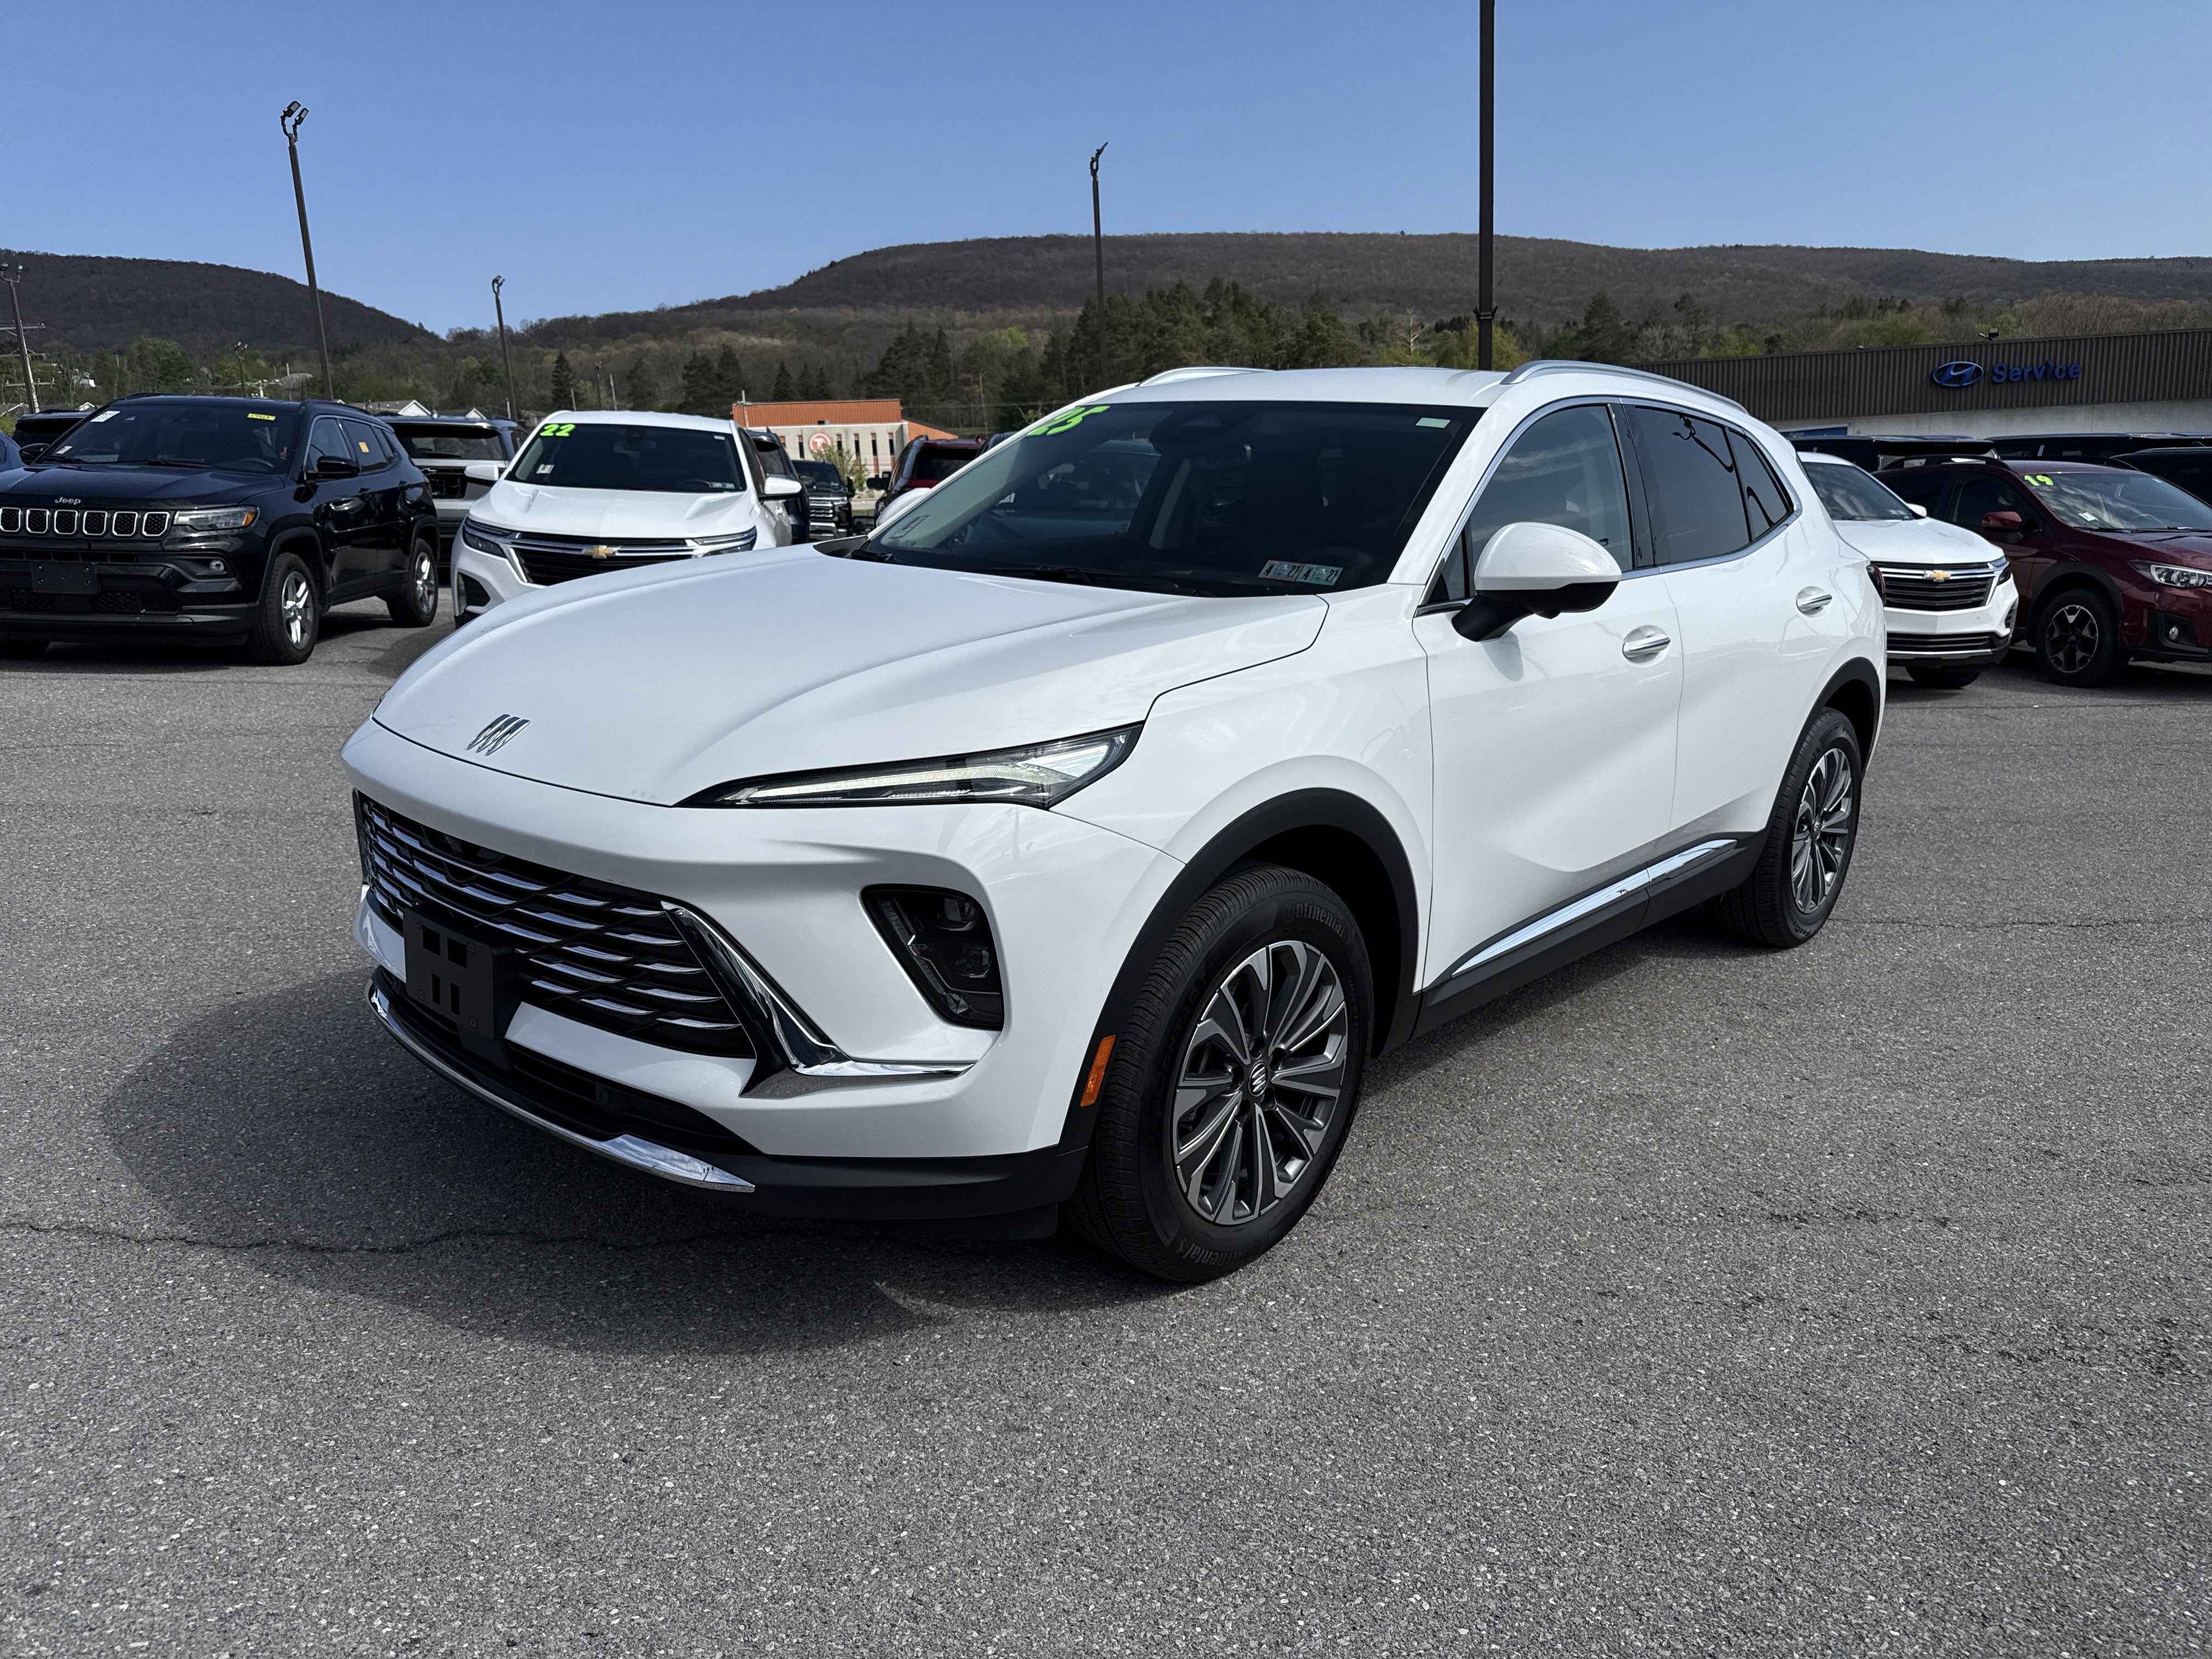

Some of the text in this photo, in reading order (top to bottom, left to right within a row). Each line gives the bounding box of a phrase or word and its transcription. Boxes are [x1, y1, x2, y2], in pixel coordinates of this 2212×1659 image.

[1992, 360, 2081, 383] Service
[1026, 405, 1111, 436] 25
[540, 424, 576, 437] 22
[2024, 475, 2054, 487] 19
[54, 496, 81, 505] Jeep
[1265, 565, 1301, 578] 4 27
[1303, 569, 1339, 583] 4 27
[1282, 898, 1346, 939] Continental
